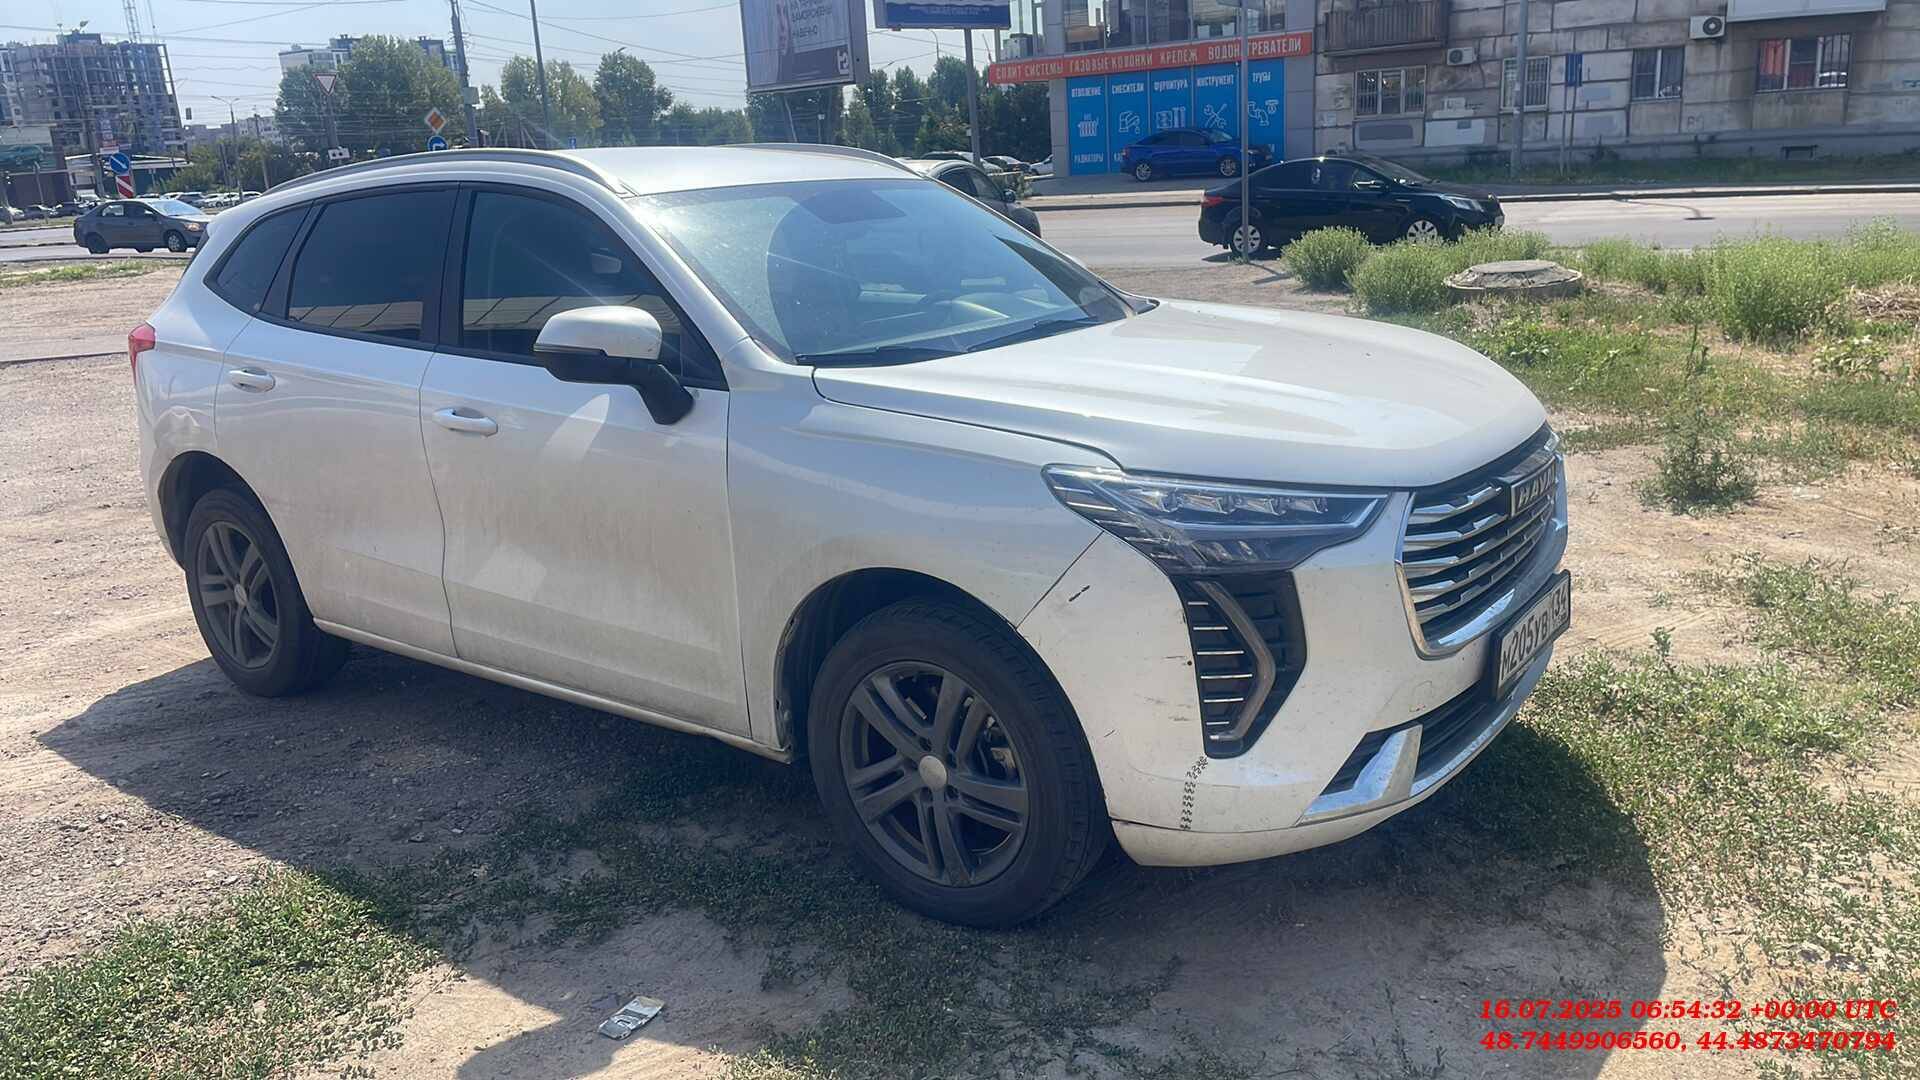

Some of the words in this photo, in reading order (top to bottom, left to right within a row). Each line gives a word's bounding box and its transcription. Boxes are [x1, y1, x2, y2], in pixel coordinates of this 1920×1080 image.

[996, 64, 1022, 80] СПЛИТ
[1025, 62, 1063, 78] СИСТЕМЫ
[1070, 58, 1109, 73] ГАЗОВЫЕ
[1112, 54, 1153, 69] КОЛОНКИ
[1160, 49, 1198, 65] КРЕПЕЖ
[1208, 37, 1302, 61] ВОДОНГРЕВАТЕЛИ
[1154, 79, 1189, 92] ФУРНИТУРА
[1196, 74, 1235, 88] ИНСТРУМЕНТ
[1111, 82, 1145, 95] СМЕСИТЕЛИ
